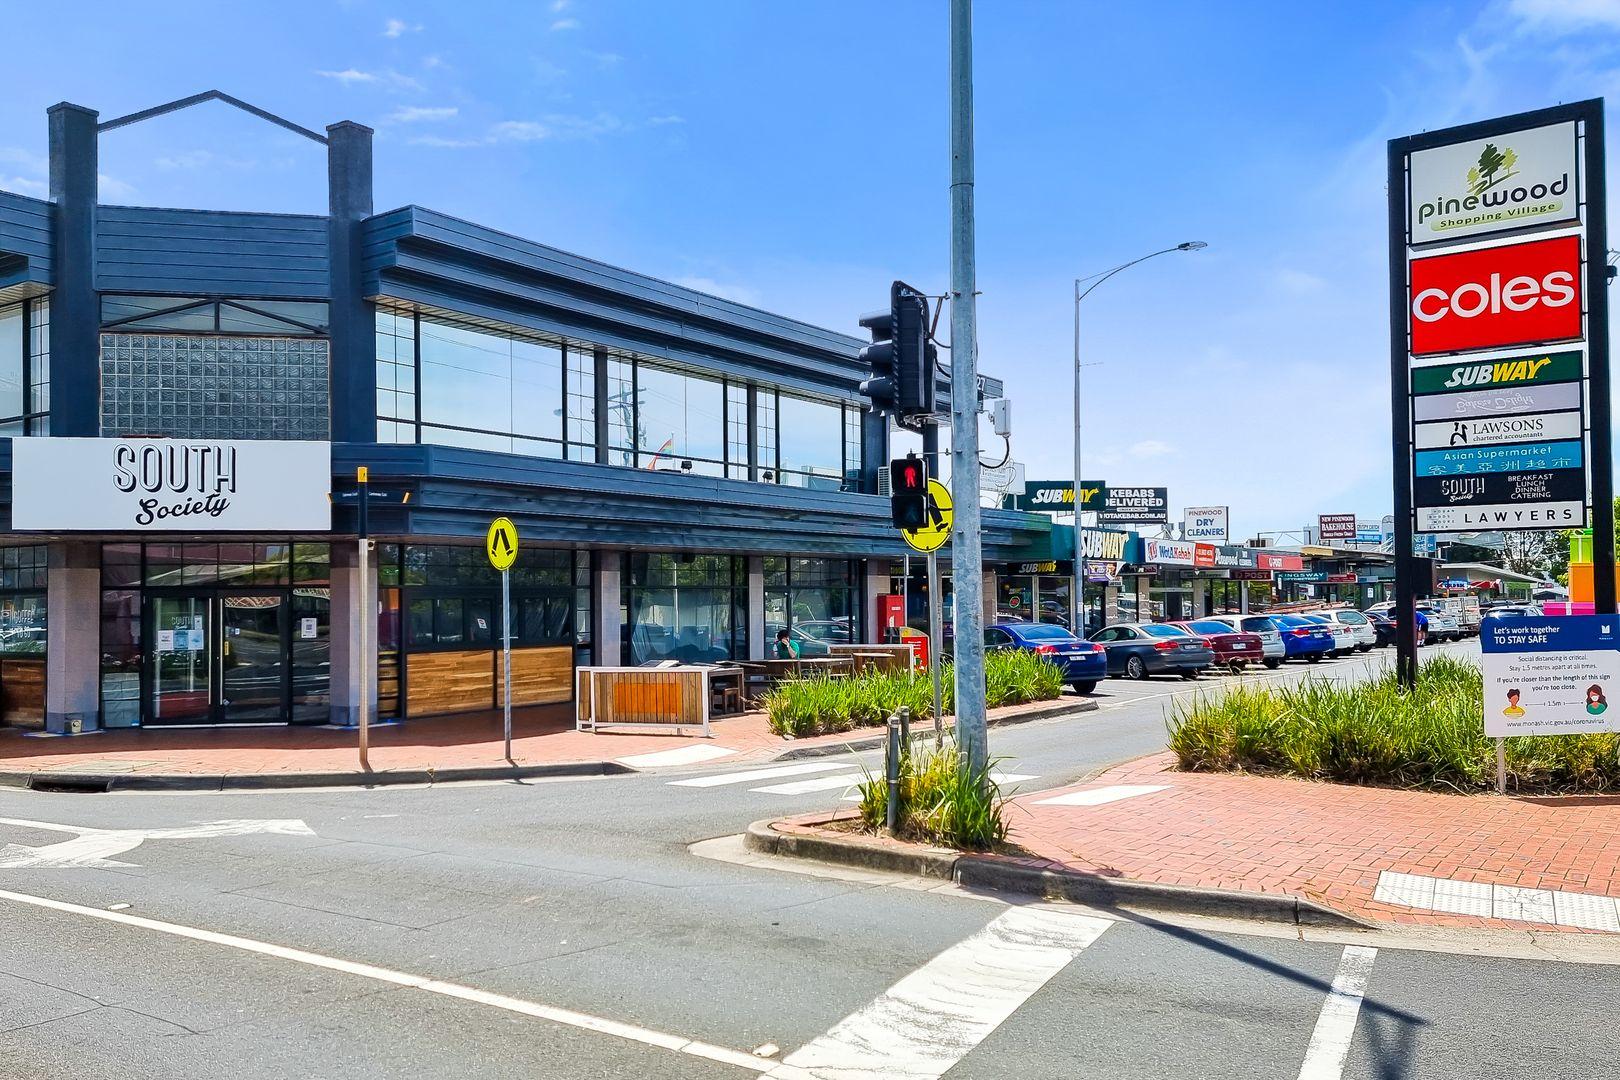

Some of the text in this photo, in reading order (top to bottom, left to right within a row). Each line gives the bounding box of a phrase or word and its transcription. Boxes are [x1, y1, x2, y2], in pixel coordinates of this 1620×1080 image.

[1418, 173, 1569, 224] pinewood
[1440, 202, 1556, 228] Shopping Village
[1412, 271, 1575, 323] coles
[1444, 357, 1551, 388] SUBWAY
[1473, 418, 1544, 435] LAWSONS
[1473, 432, 1543, 442] chartered accountants
[1444, 446, 1552, 461] Asian Supermarket
[113, 443, 236, 493] SOUTH
[1508, 473, 1553, 482] BREAKFAST
[1516, 480, 1545, 488] LUNCH
[1441, 477, 1485, 496] SOUTH
[1110, 489, 1155, 498] KEBABS
[1510, 492, 1551, 500] CATERING
[135, 493, 231, 525] Society
[1465, 509, 1572, 523] LAWYERS
[1187, 528, 1225, 536] CLEANERS
[1321, 522, 1354, 531] BAKEHOUSE
[1081, 529, 1129, 559] SUBWAY
[1018, 560, 1057, 573] SUBWAY
[1511, 626, 1529, 634] work
[1530, 626, 1560, 635] together
[1494, 635, 1548, 644] TO STAY SAFE
[1502, 676, 1520, 684] you're
[1563, 674, 1580, 682] length
[1532, 684, 1550, 692] you're
